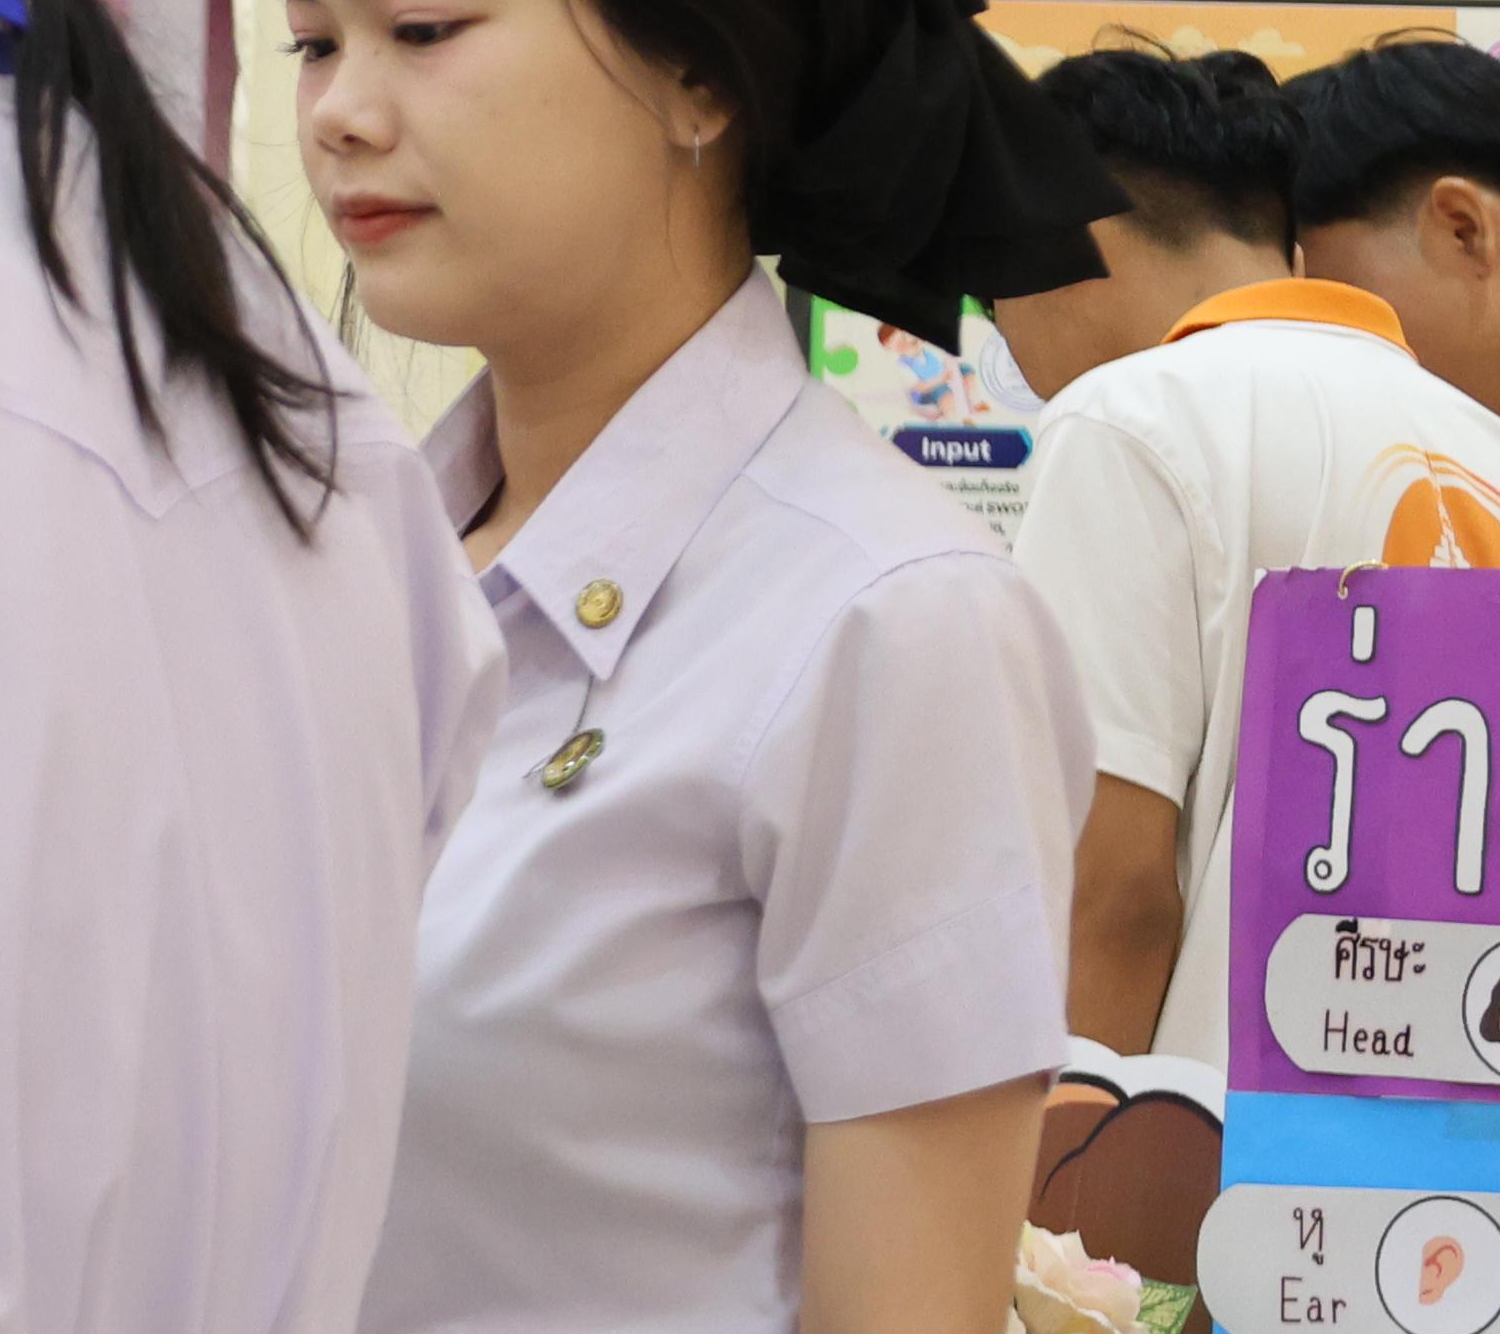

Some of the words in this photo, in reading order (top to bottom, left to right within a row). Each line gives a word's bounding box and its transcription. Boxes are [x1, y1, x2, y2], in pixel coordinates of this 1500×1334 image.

[922, 436, 992, 465] Input
[987, 501, 1029, 515] SWO
[1334, 919, 1426, 982] ศีรษะ
[1323, 1010, 1414, 1058] Head
[1293, 1207, 1324, 1265] หู
[1281, 1276, 1347, 1323] Ear
